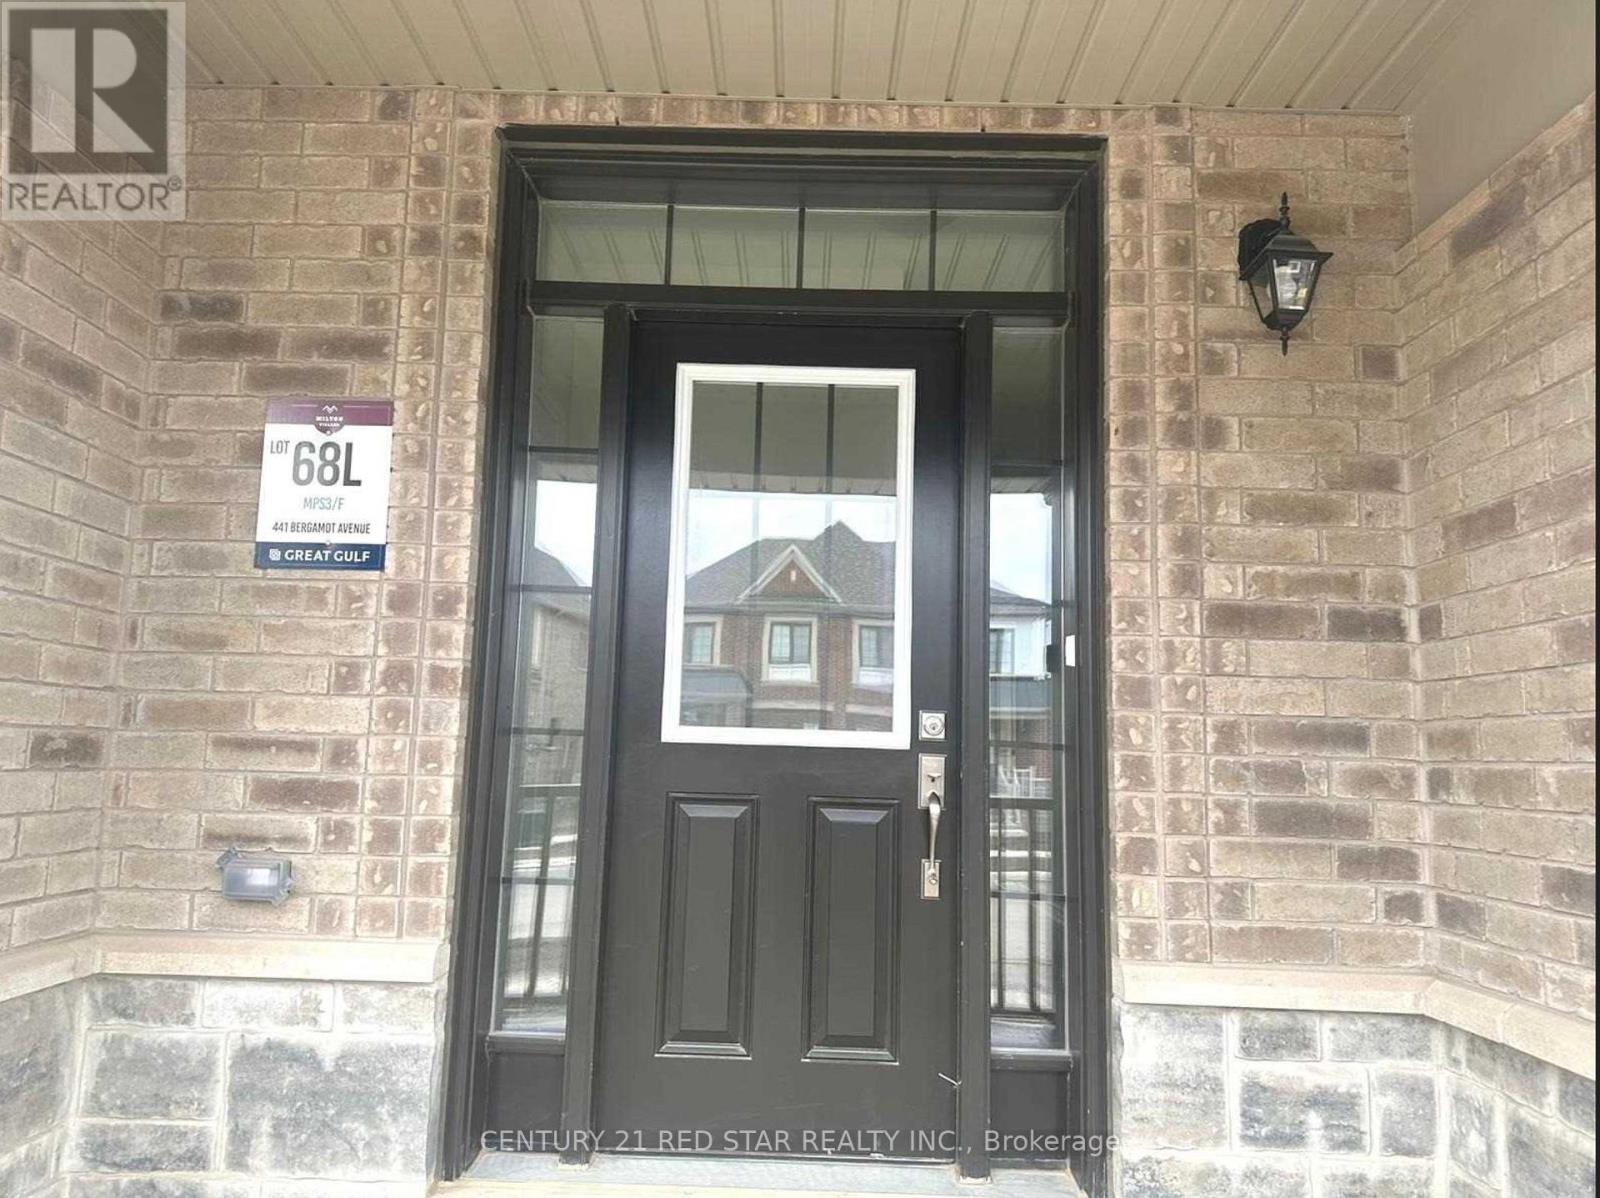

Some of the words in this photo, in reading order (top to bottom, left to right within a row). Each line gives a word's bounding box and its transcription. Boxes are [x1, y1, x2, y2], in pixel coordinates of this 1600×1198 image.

[269, 440, 290, 454] LOT
[292, 441, 362, 487] 68L
[303, 497, 345, 511] MPS3/F
[272, 521, 289, 533] 441
[290, 522, 336, 534] BERGAMOT
[337, 522, 371, 534] AVENUE
[284, 549, 331, 562] GREAT
[334, 550, 371, 562] GULF
